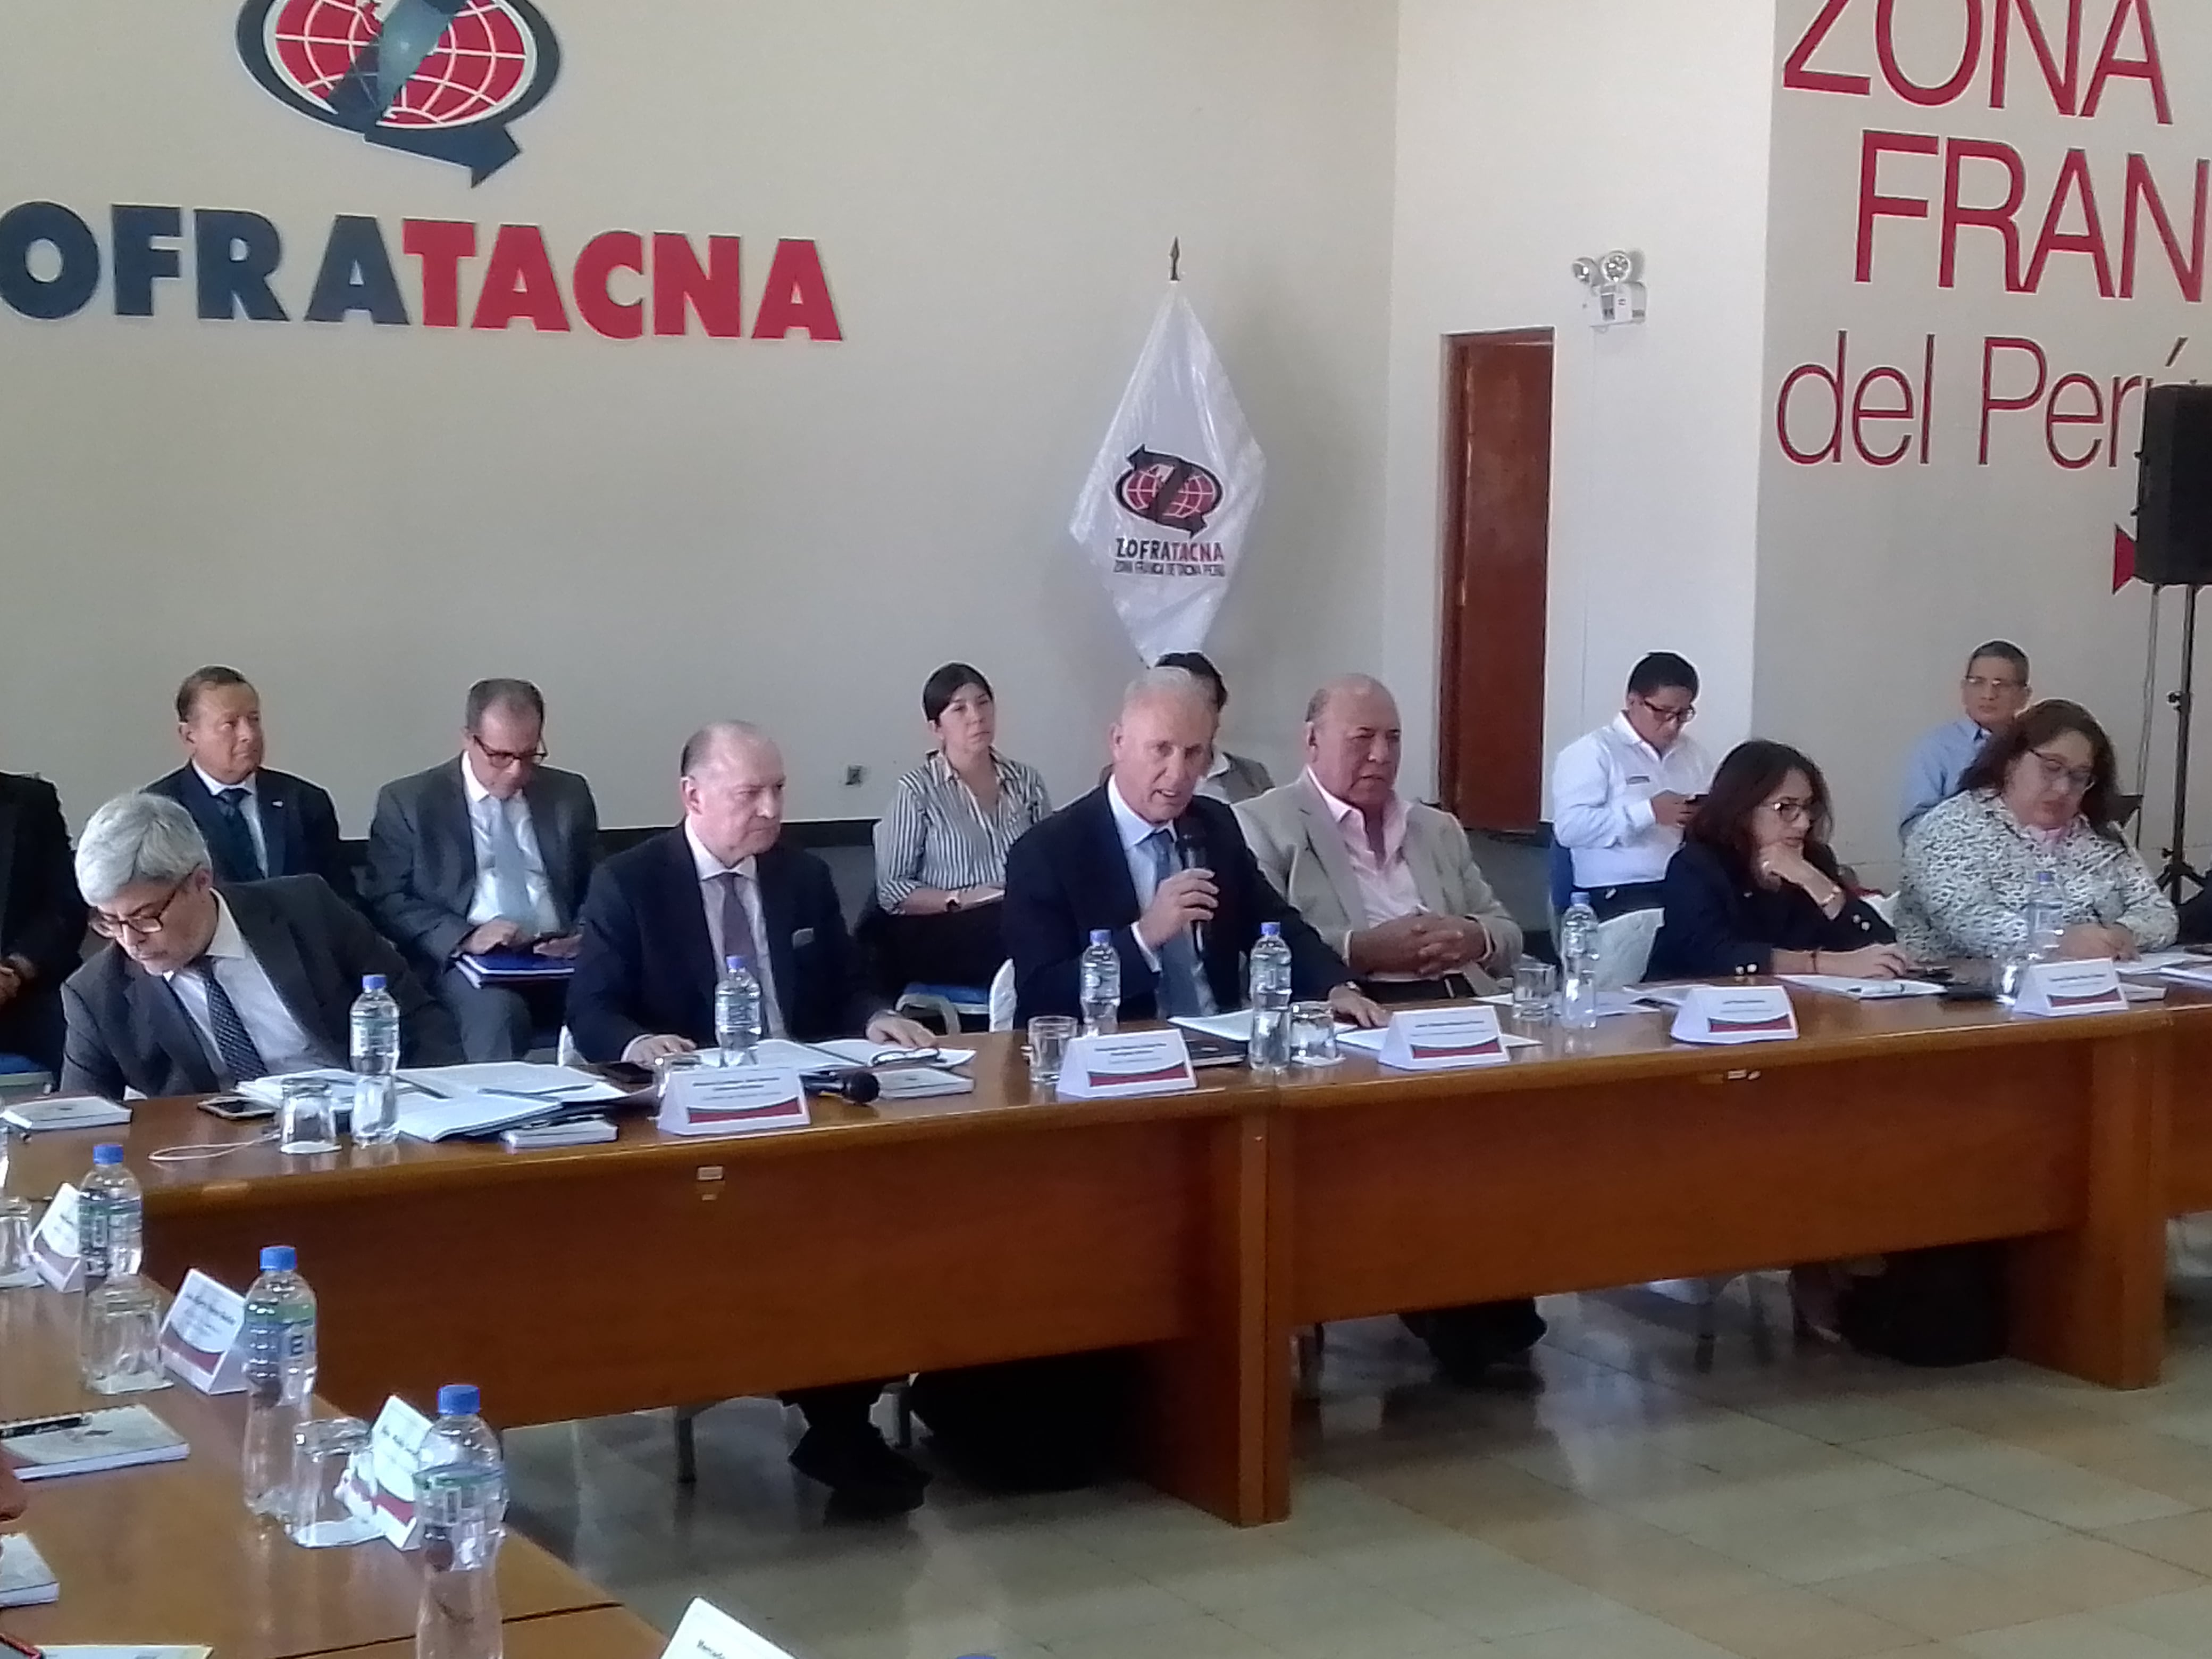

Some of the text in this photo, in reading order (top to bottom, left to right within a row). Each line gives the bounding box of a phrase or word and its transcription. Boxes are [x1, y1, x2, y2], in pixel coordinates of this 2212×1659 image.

[1783, 0, 2173, 125] ZONA
[0, 200, 843, 342] OFRATACNA
[1855, 130, 2210, 303] FRAN
[1776, 330, 2199, 469] del Per
[1116, 538, 1225, 562] ZOFRATACNA
